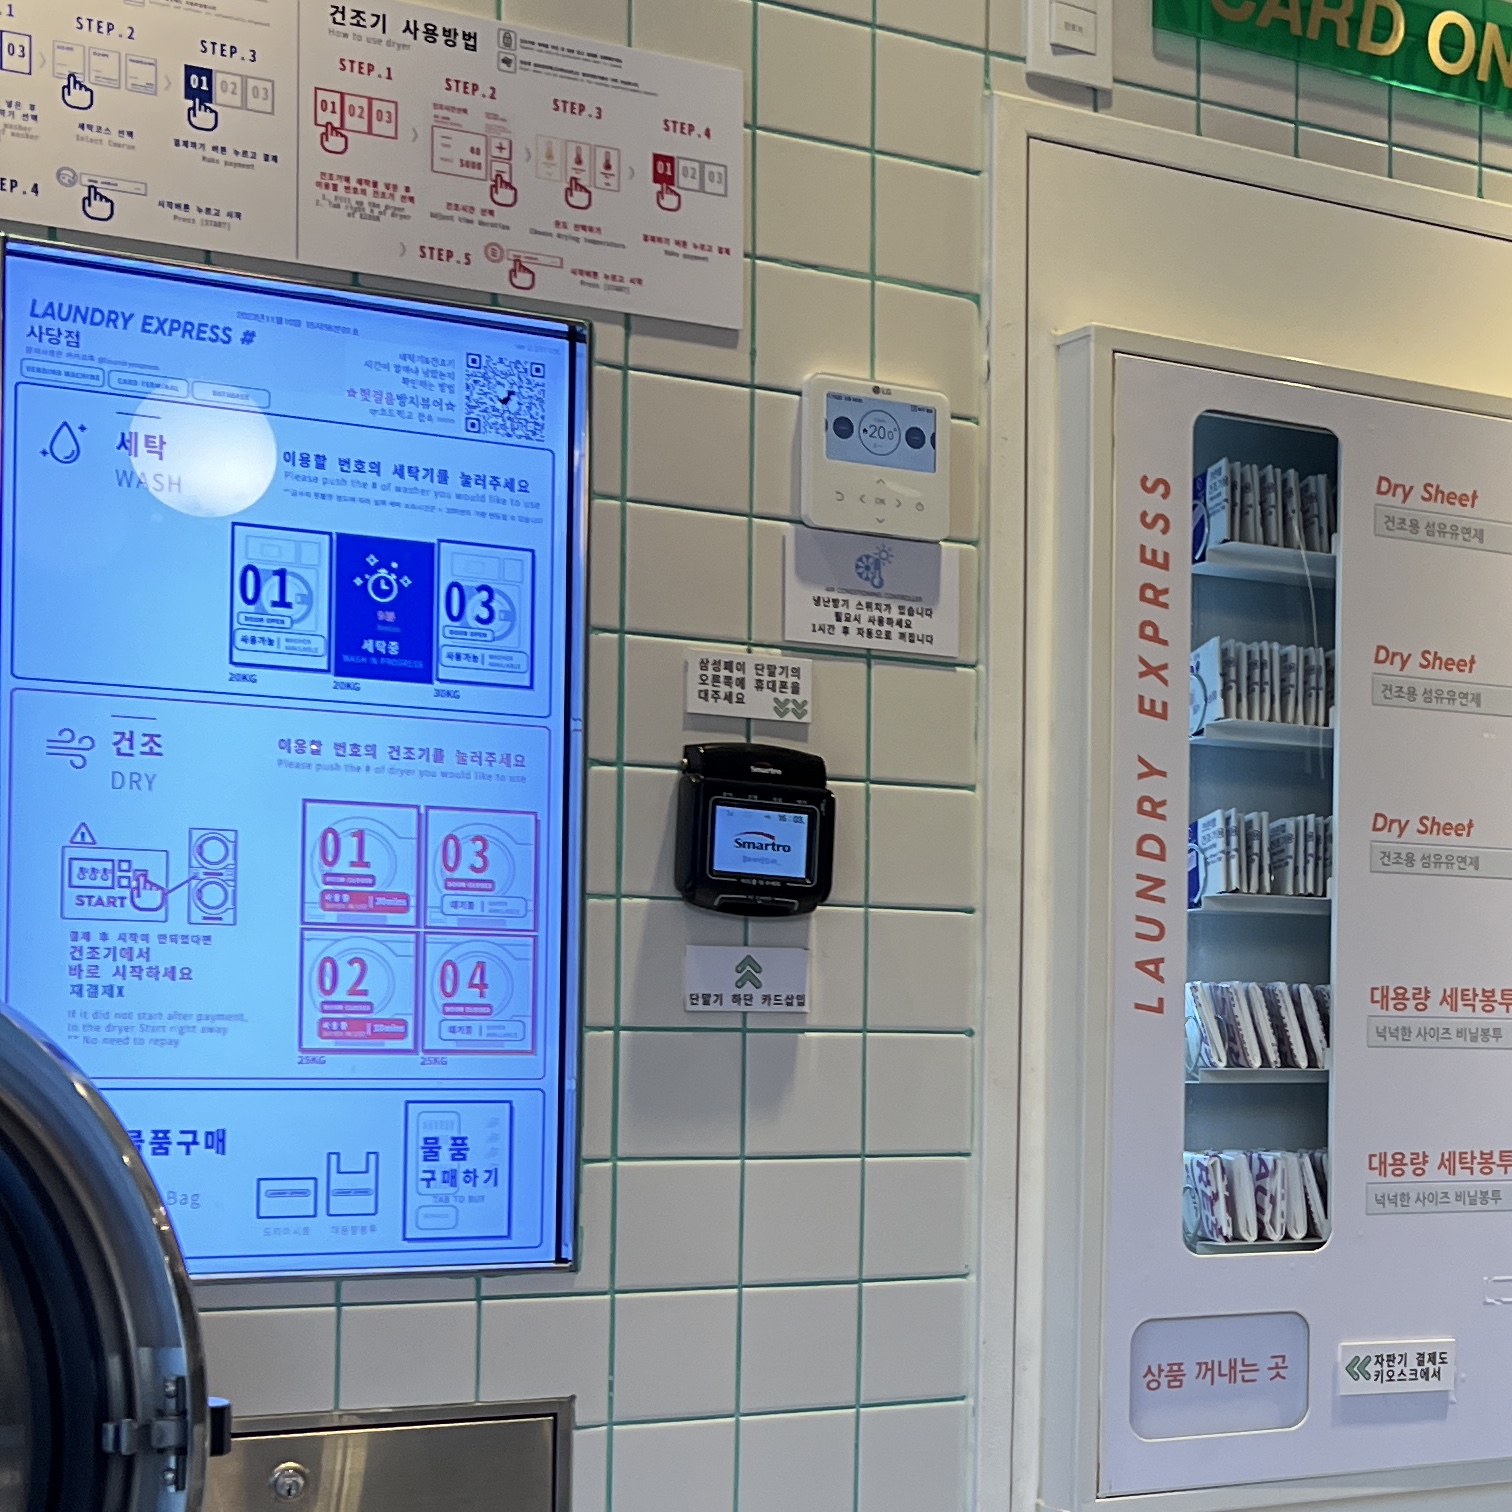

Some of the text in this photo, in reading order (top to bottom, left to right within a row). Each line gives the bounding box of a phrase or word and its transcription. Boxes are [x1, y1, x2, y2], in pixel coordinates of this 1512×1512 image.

[76, 16, 135, 40] STEP.2
[329, 4, 478, 52] 건조기 사용방법
[7, 43, 26, 58] 03
[200, 39, 257, 63] STEP.3
[339, 58, 393, 80] STEP.1
[190, 74, 208, 91] 01
[220, 80, 238, 96] 02
[252, 85, 269, 101] 03
[444, 78, 497, 100] STEP.2
[320, 99, 337, 114] 01
[348, 104, 365, 120] 02
[376, 109, 392, 124] 03
[553, 98, 603, 119] STEP.3
[663, 119, 711, 139] STEP.4
[657, 161, 672, 175] 01
[682, 165, 696, 179] 02
[709, 171, 723, 184] 03
[419, 246, 472, 265] STEP.5
[29, 299, 134, 331] LAUNDRY
[140, 315, 232, 345] EXPRESS
[26, 324, 81, 348] 사당점
[116, 431, 167, 461] 세탁
[115, 468, 182, 494] WASH
[282, 450, 530, 494] 이용할 번호의 세탁기를 눌러주세요
[284, 470, 319, 485] Please
[322, 475, 347, 489] push
[350, 478, 368, 489] the
[395, 483, 430, 497] washer
[1376, 475, 1478, 508] Dry Sheet
[1383, 515, 1485, 544] 건조용 섬유유연제
[239, 563, 293, 609] 01
[445, 581, 496, 626] 03
[856, 600, 892, 614] 스위치가
[868, 615, 912, 629] 사용하세요
[699, 658, 801, 679] 삼성페이 단말기의
[1374, 644, 1477, 674] Dry Sheet
[699, 674, 800, 694] 오른쪽에 휴대폰을
[698, 689, 746, 705] 대주세요
[1381, 683, 1482, 708] 건조용 섬유유연제
[111, 729, 164, 758] 건조
[277, 738, 526, 769] 이용할 번호의 건조기를 눌러주세요
[1134, 474, 1171, 1015] LAUNDRY EXPRESS
[111, 770, 157, 791] DRY
[750, 765, 782, 776] Smartro
[1371, 812, 1475, 838] Dry Sheet
[319, 827, 371, 868] 01
[442, 834, 490, 874] 03
[733, 837, 791, 854] Smartro
[1379, 851, 1480, 871] 건조용 섬유유연제
[75, 894, 128, 909] START
[69, 946, 151, 962] 건조기에서
[69, 964, 194, 982] 바로 시작하세요
[317, 957, 369, 997] 02
[439, 960, 489, 999] 04
[689, 993, 806, 1008] 단말기 하단 카드삽입
[1370, 985, 1431, 1013] 대용량
[104, 1023, 136, 1036] dryer
[1375, 1025, 1503, 1043] 넉넉한 사이즈 비닐봉투
[1368, 1151, 1429, 1178] 대용량
[420, 1168, 499, 1188] 구매하기
[166, 1190, 201, 1209] Bag
[1374, 1189, 1503, 1208] 넉넉한 사이즈 비닐봉투
[1374, 1351, 1449, 1368] 자판기 결제도
[1141, 1354, 1290, 1392] 상품 꺼내는 곳
[1374, 1366, 1441, 1384] 키오스크에서
